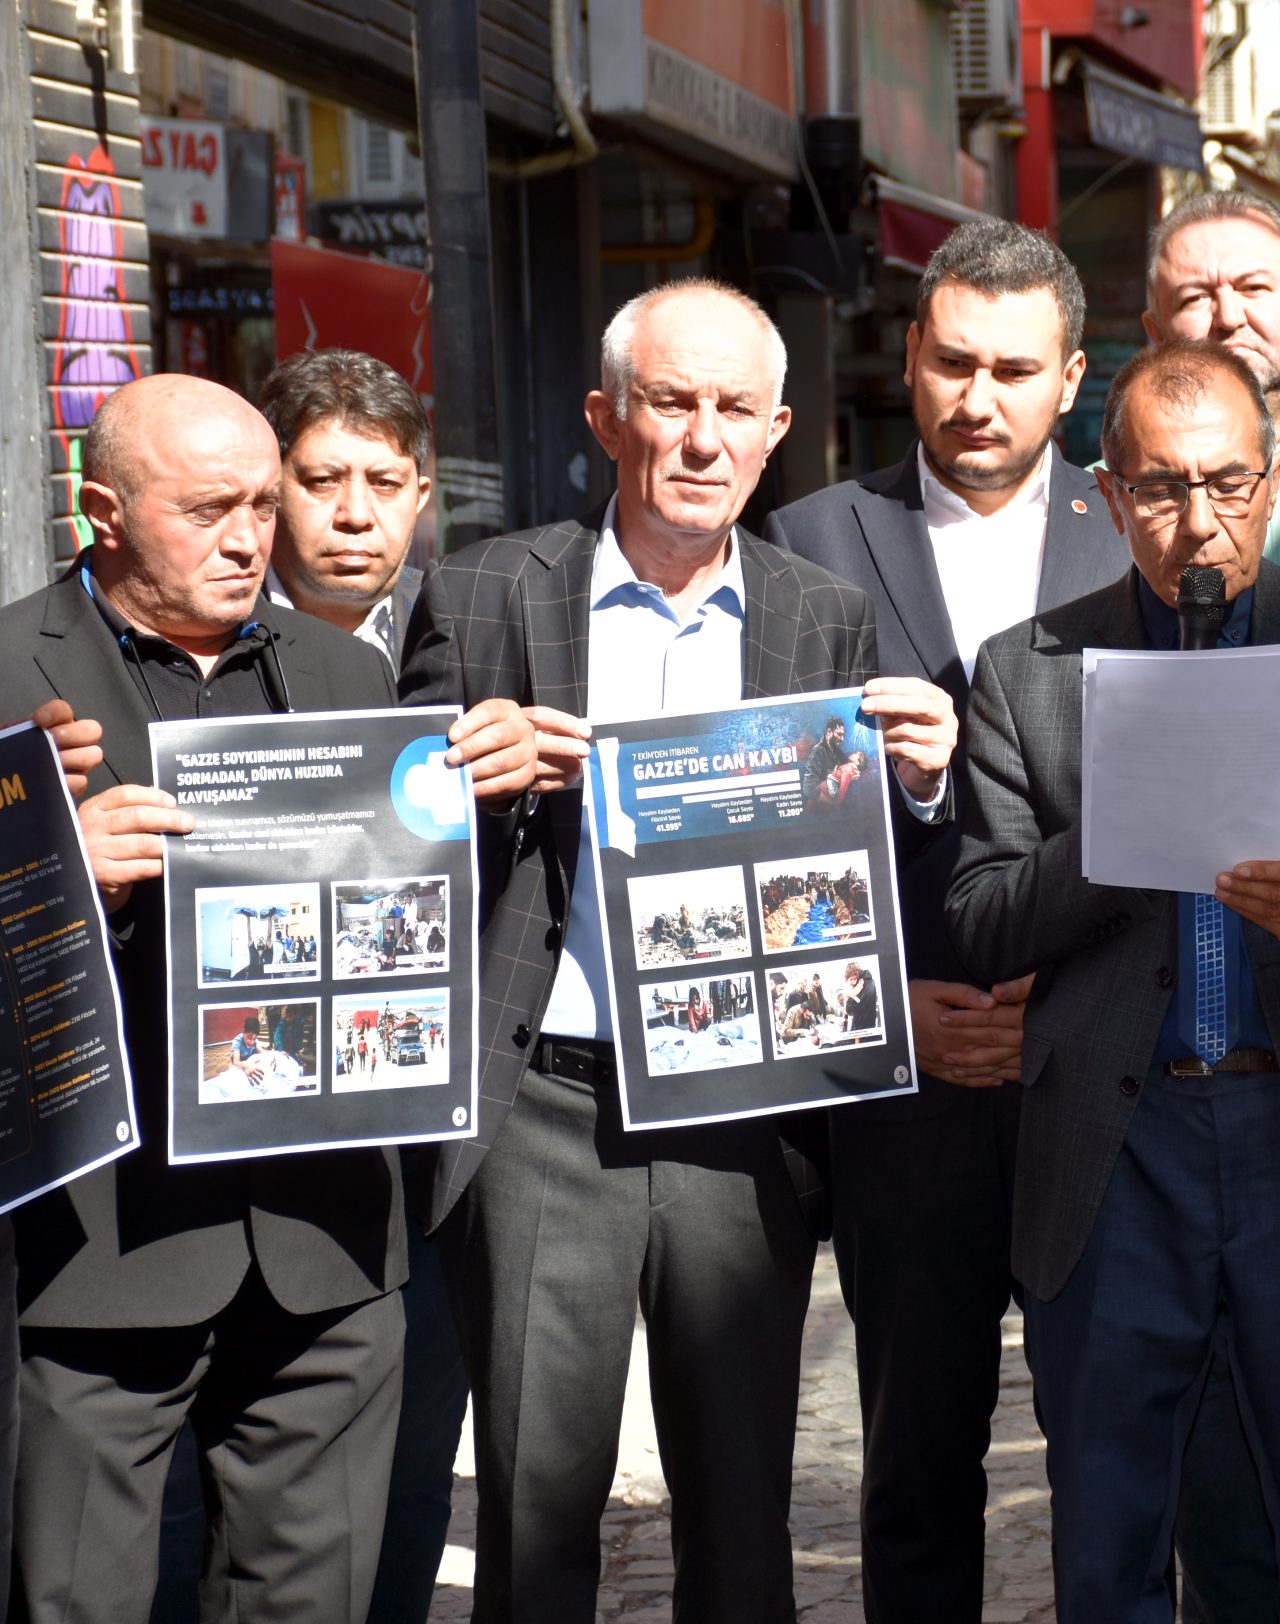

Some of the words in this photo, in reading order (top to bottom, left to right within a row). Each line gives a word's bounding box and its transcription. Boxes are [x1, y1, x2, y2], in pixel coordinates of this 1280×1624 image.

[176, 752, 220, 768] "GAZZE
[223, 748, 306, 765] SOYKIRIMININ
[308, 745, 363, 760] HESABINI
[632, 753, 637, 761] 7
[638, 749, 669, 761] EKİM'DEN
[669, 746, 699, 758] İTİBAREN
[633, 757, 709, 780] GAZZE'DE
[712, 754, 745, 772] CAN
[748, 746, 798, 768] KAYBI
[177, 770, 249, 786] SORMADAN,
[251, 766, 292, 782] DÜNYA
[295, 764, 343, 779] HUZURA
[178, 787, 258, 805] KAVUŞAMAZ"
[899, 1071, 904, 1079] 5
